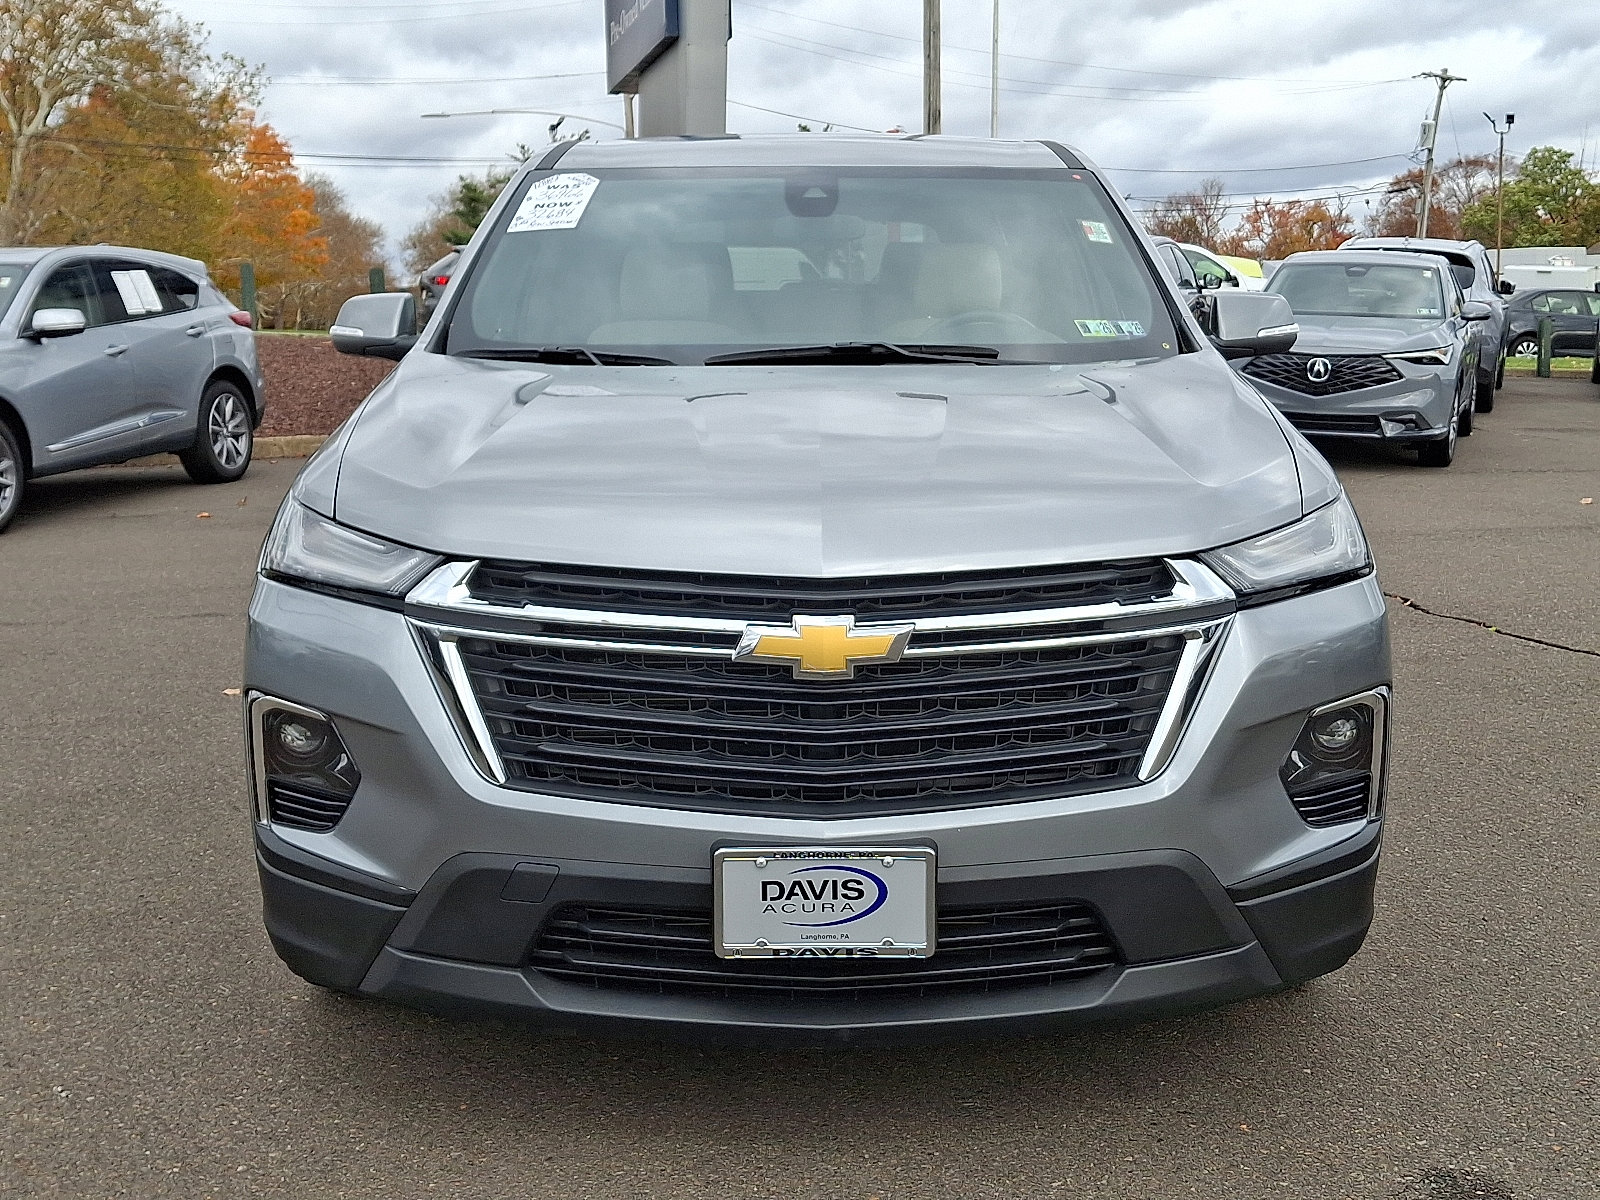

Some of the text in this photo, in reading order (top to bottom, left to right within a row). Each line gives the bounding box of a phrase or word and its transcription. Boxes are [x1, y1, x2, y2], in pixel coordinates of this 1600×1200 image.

[534, 201, 573, 210] NOW
[761, 878, 866, 902] DAVIS
[762, 902, 856, 914] ACURA
[772, 947, 879, 957] DAVIS
